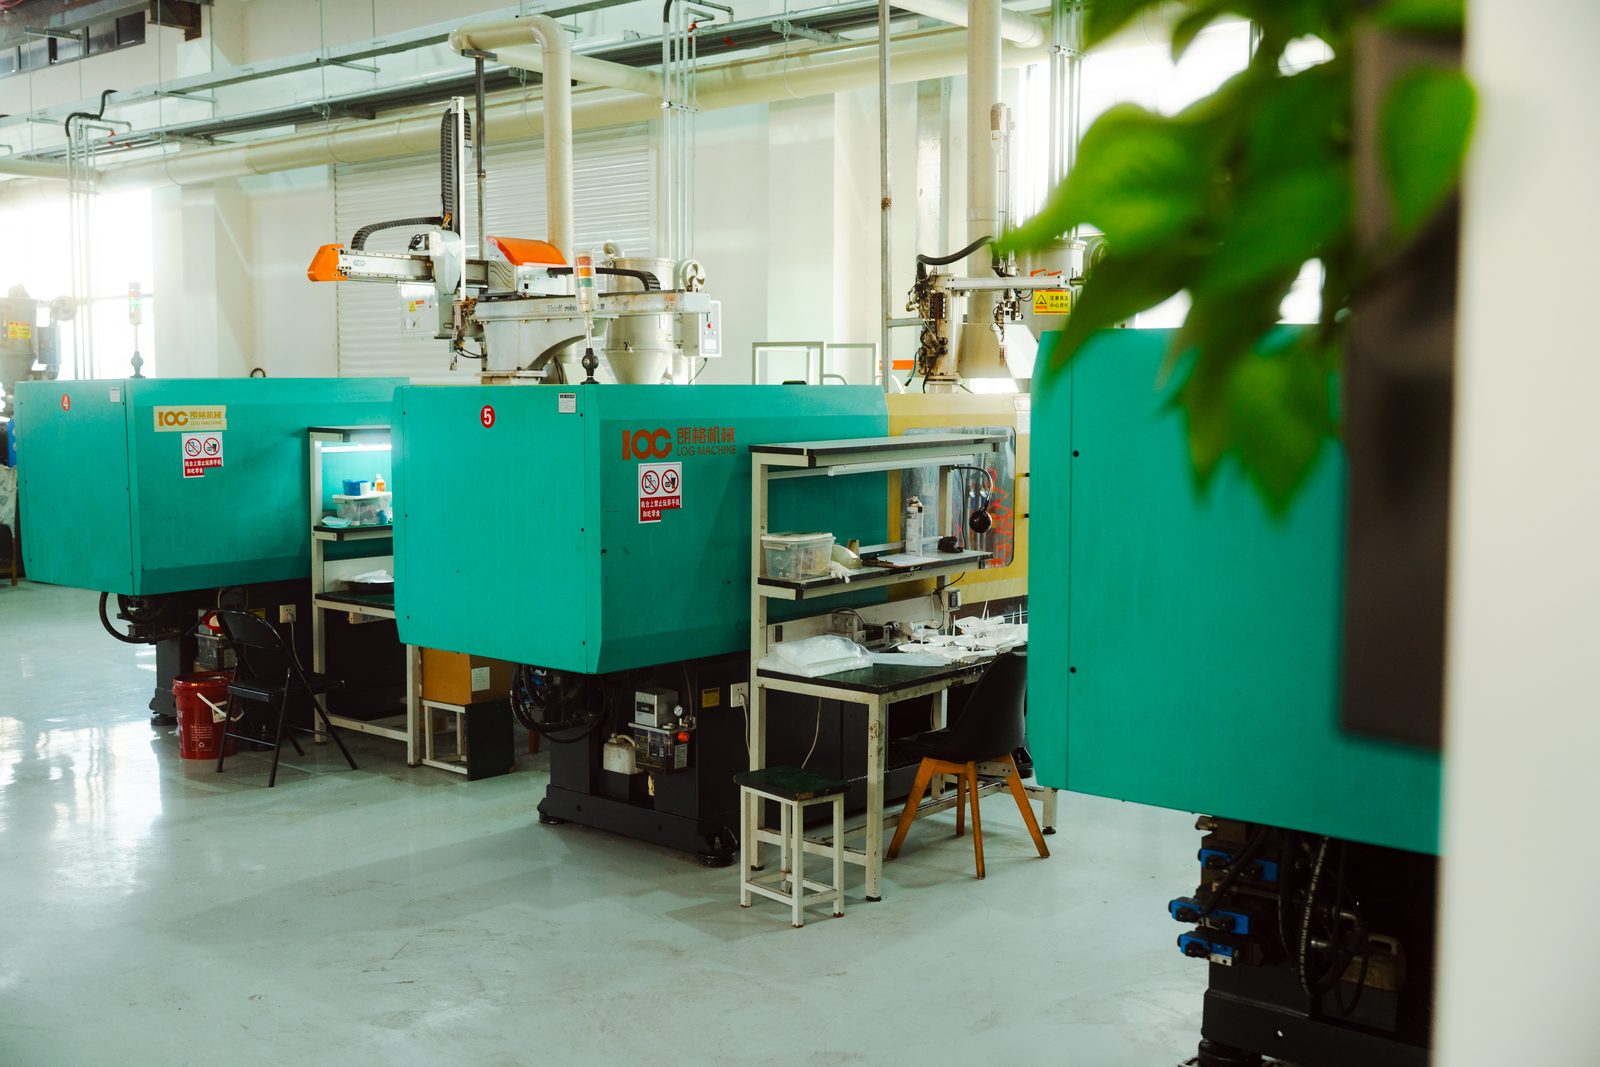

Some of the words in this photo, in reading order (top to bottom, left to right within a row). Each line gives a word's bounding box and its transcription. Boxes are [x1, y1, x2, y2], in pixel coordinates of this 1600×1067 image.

[63, 395, 69, 409] 4
[483, 408, 492, 426] 5
[677, 426, 736, 444] 朗格机械
[676, 446, 696, 456] LOG
[698, 445, 737, 455] MACHINE
